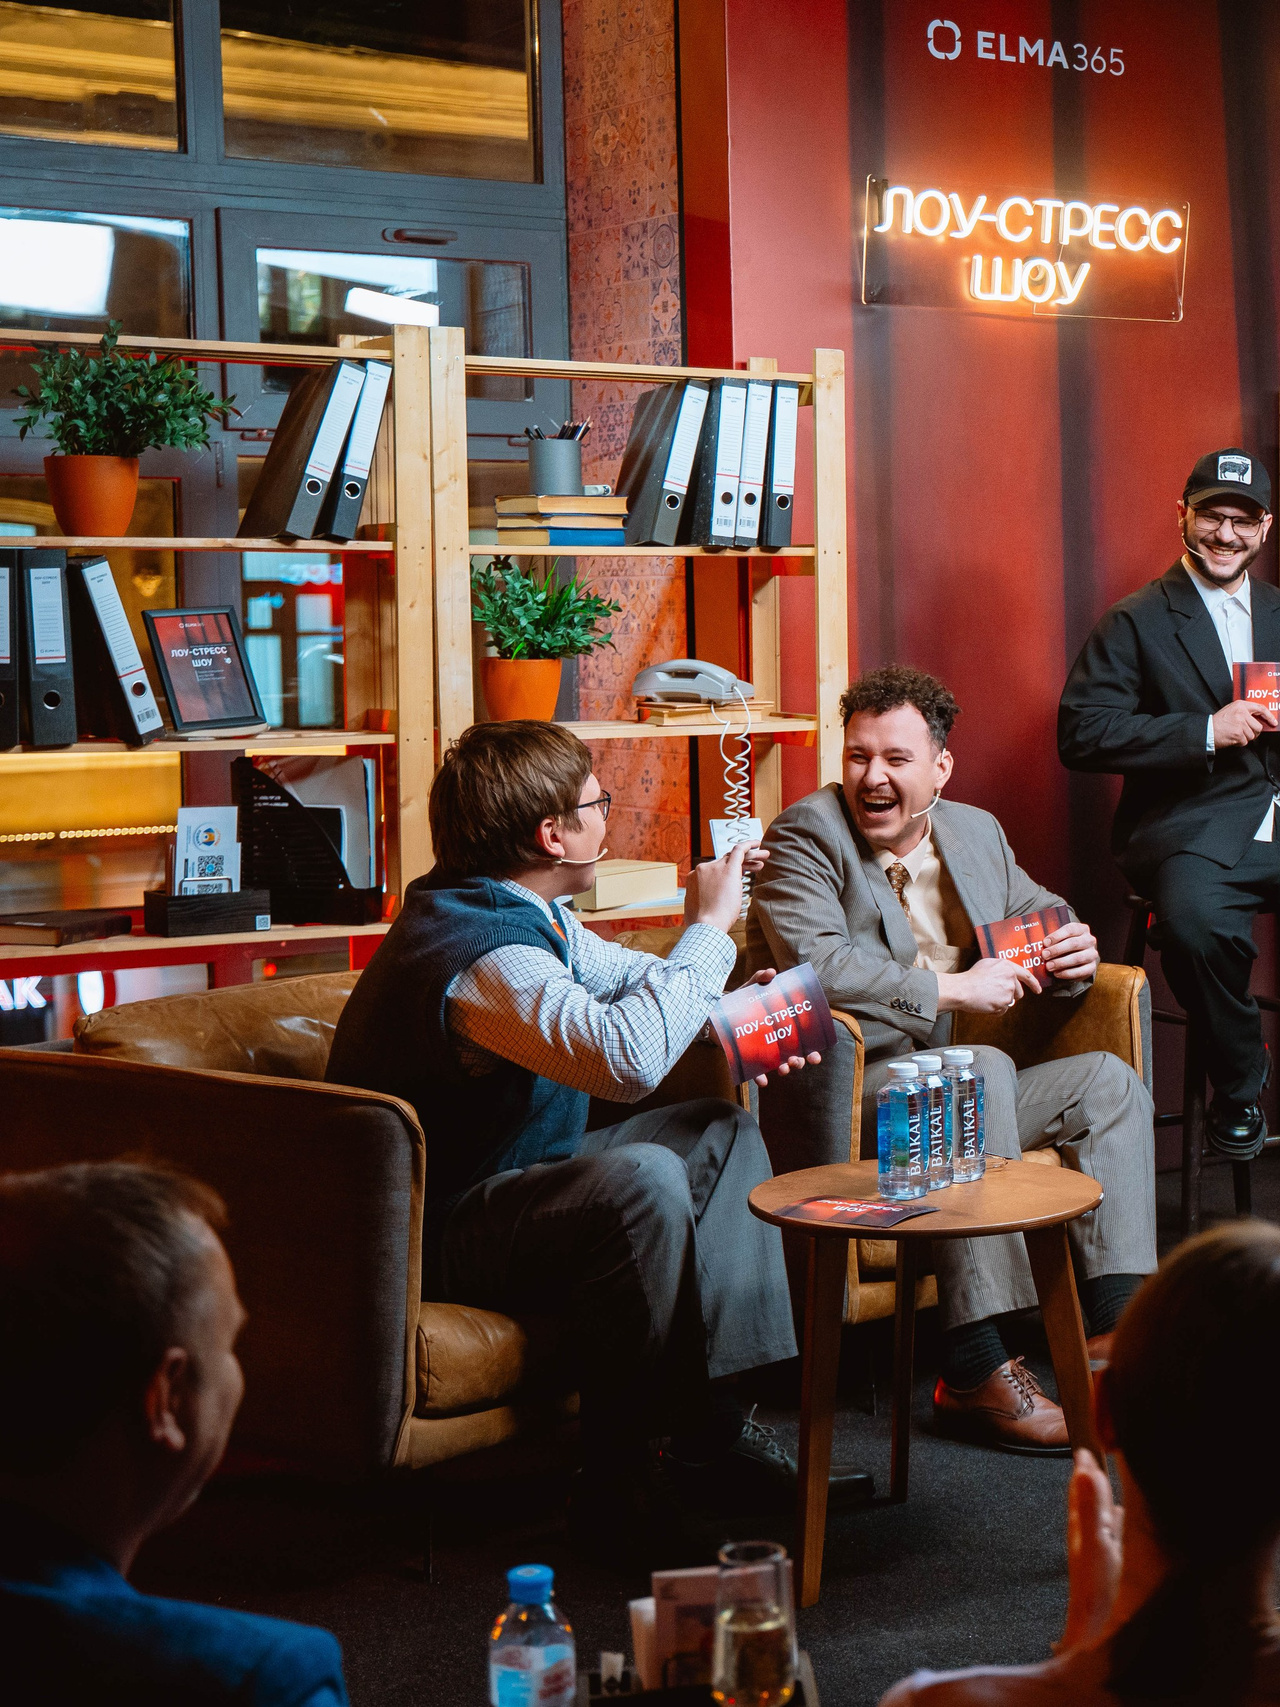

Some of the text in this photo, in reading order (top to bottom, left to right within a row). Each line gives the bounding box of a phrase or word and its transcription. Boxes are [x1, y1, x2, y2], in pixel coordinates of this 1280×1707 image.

[977, 31, 1126, 76] ELMA365
[873, 186, 1183, 254] ЛОУ-СТРЕСС
[970, 254, 1091, 305] ШОУ
[171, 646, 228, 658] ЛОУ-СТРЕСС
[191, 658, 213, 668] ШОУ
[998, 941, 1044, 960] ЛОУ-СТР
[1022, 956, 1044, 969] ШО
[734, 1000, 813, 1039] ЛОУ-СТРЕСС
[764, 1024, 793, 1045] ШОУ
[909, 1113, 921, 1176] BAIKAL
[930, 1105, 943, 1168] BAIKAL
[963, 1098, 976, 1160] BAIKAL
